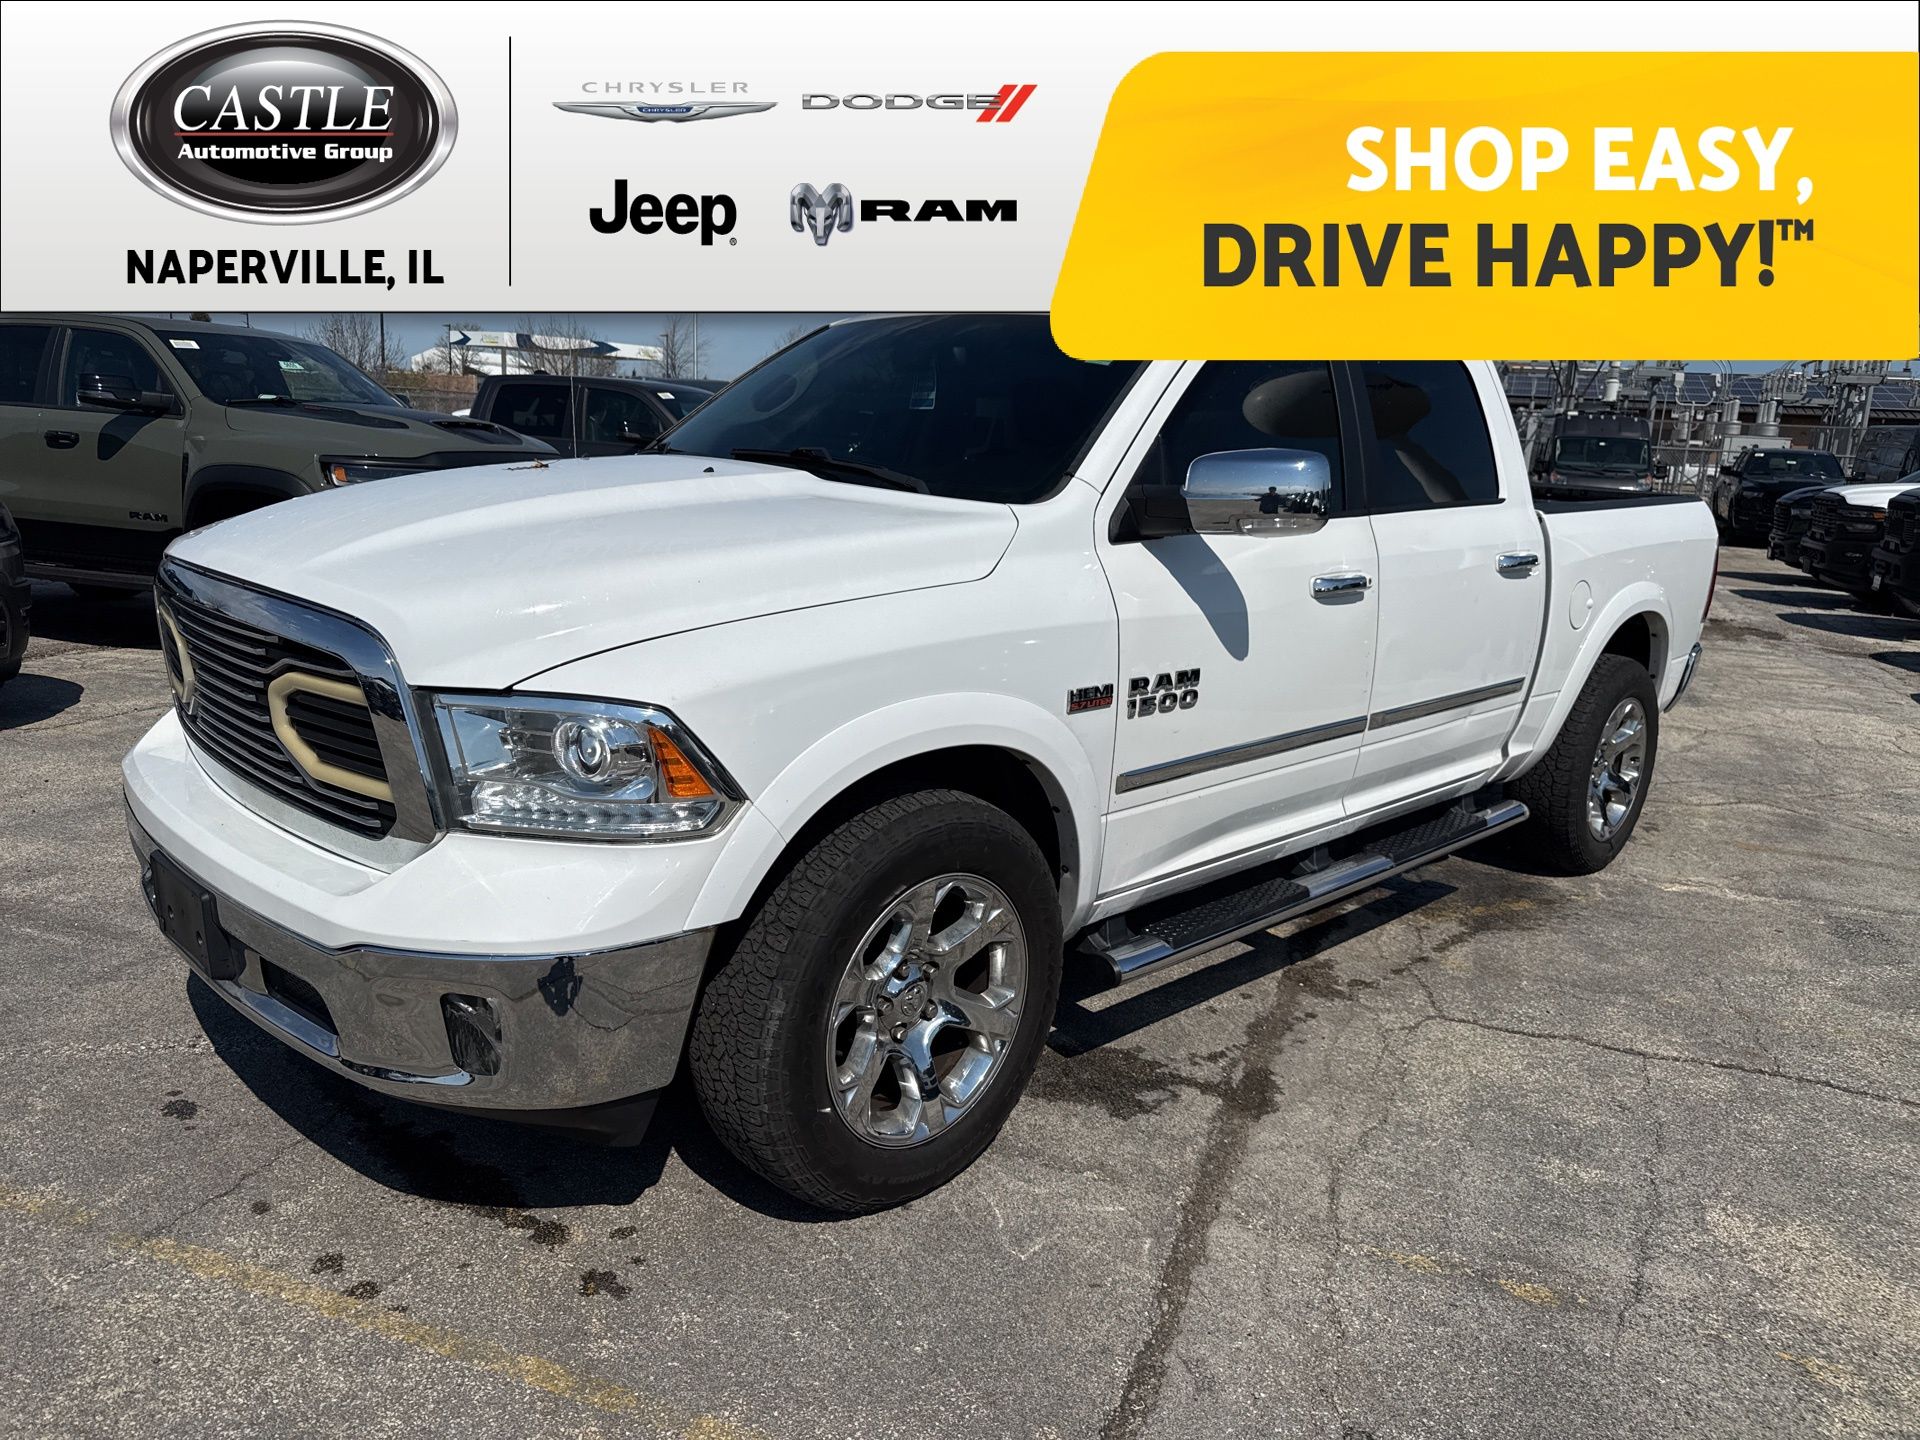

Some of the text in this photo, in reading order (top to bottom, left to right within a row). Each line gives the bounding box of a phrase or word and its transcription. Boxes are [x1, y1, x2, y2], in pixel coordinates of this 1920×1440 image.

[129, 511, 168, 522] RAM
[1070, 684, 1113, 701] HEMI
[1128, 668, 1201, 698] RAM
[1127, 689, 1199, 720] 1500
